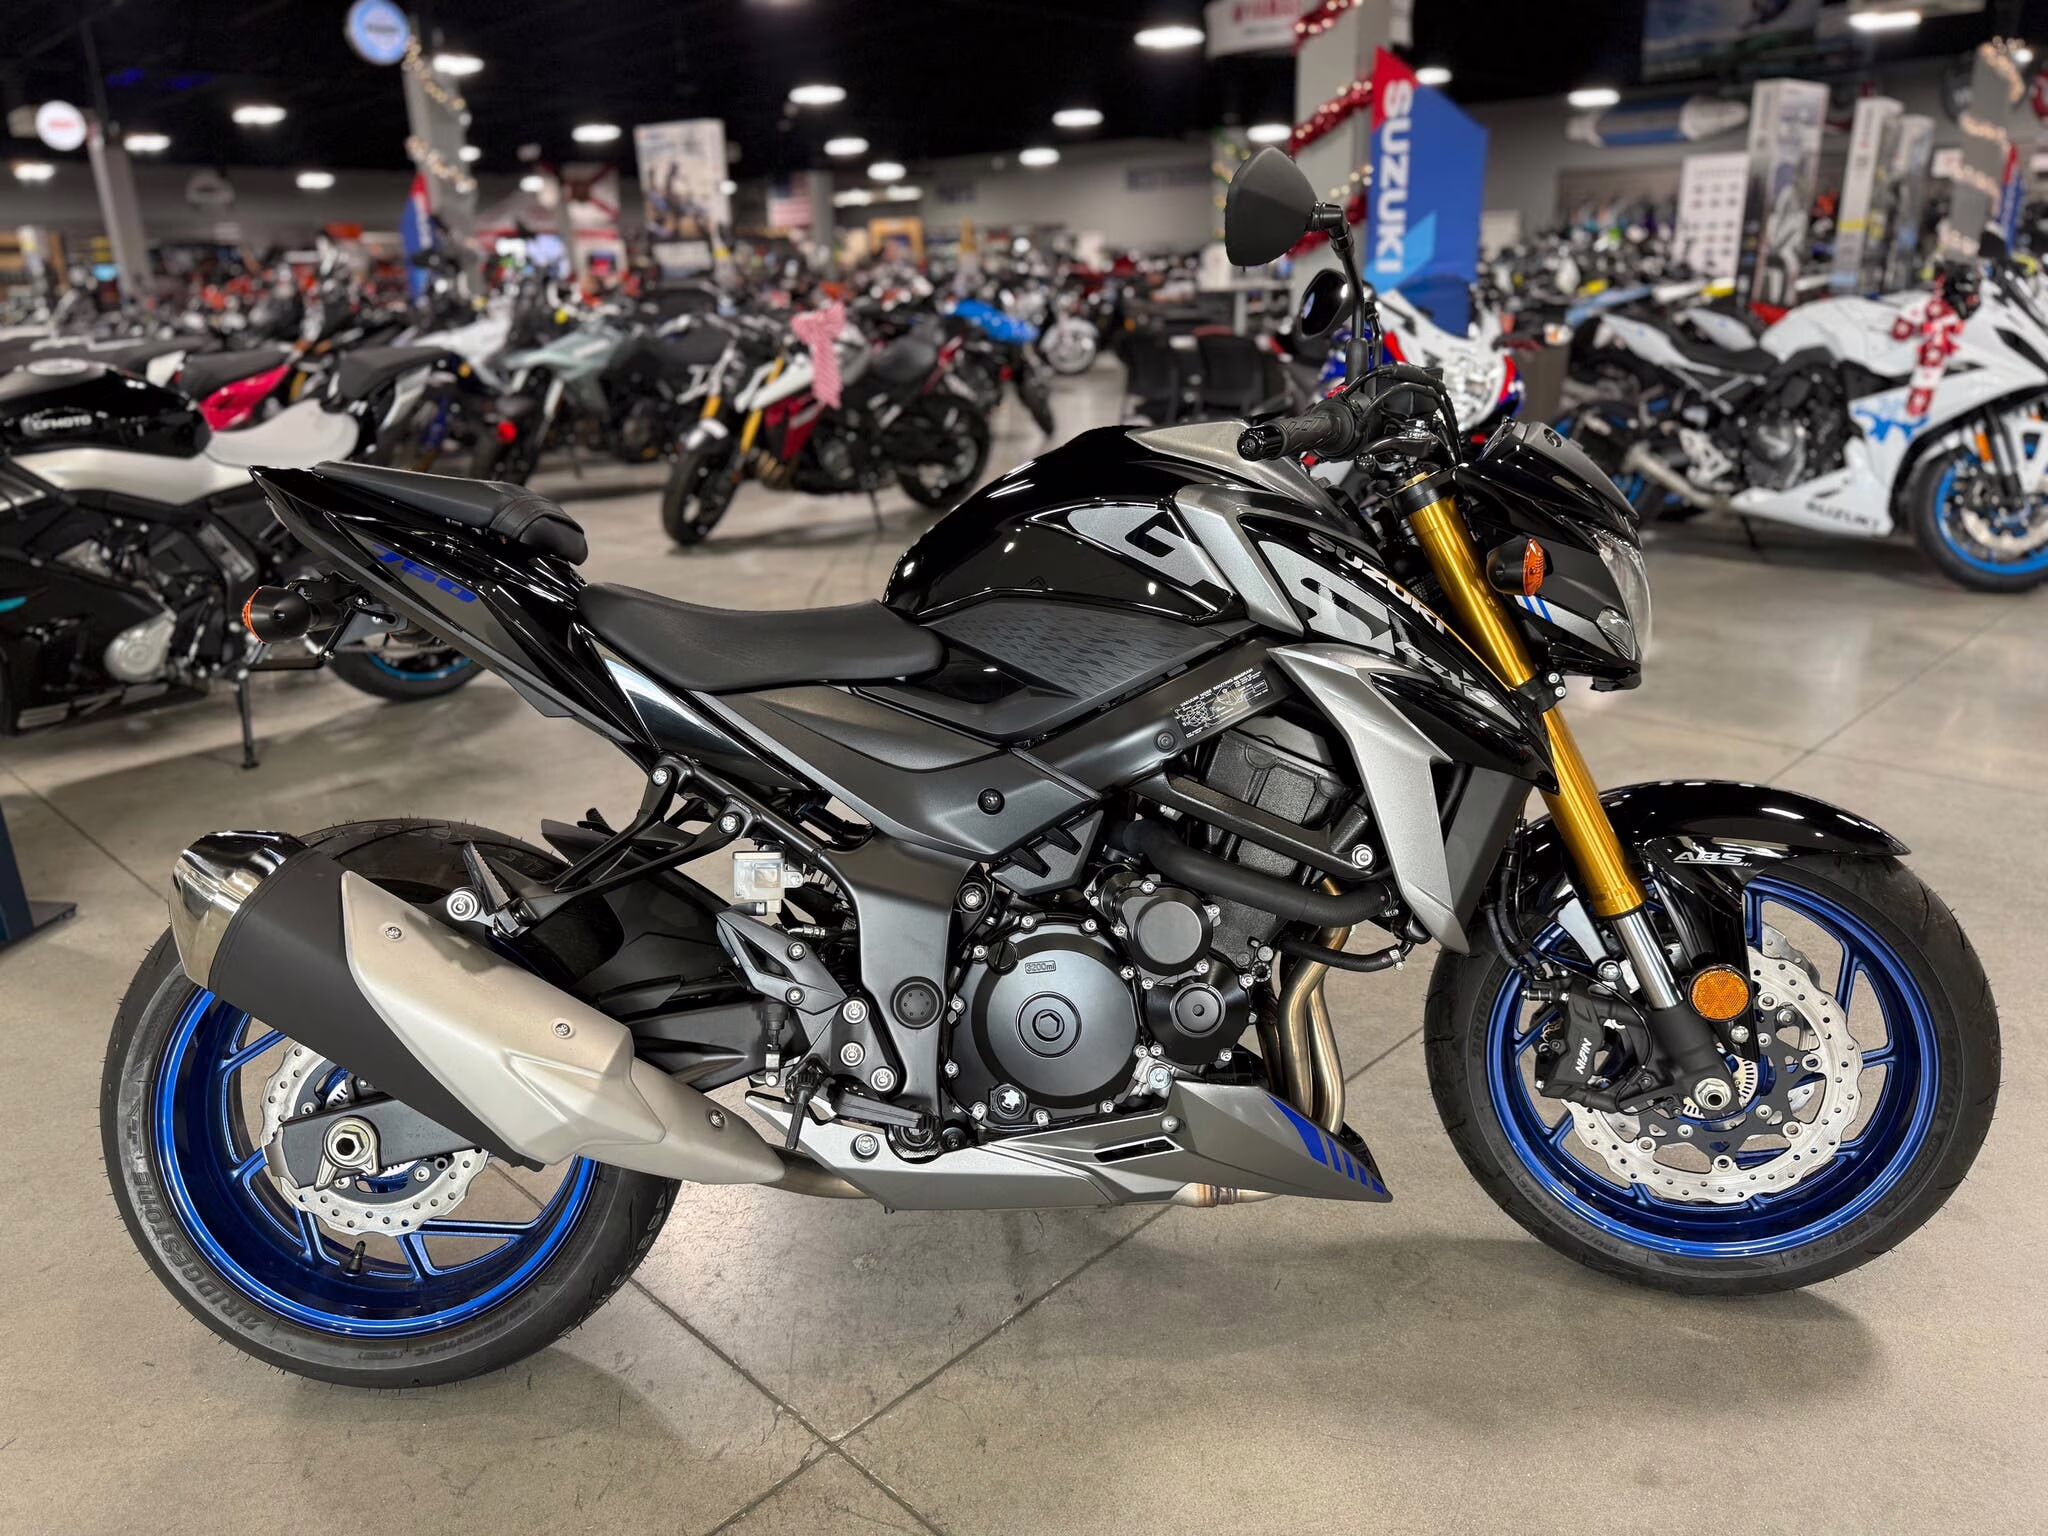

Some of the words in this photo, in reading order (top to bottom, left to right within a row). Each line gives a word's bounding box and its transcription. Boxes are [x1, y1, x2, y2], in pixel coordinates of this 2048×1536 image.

[1376, 79, 1414, 273] SUZUKI
[1805, 500, 1881, 530] SUZUKI
[372, 543, 479, 604] 750
[1307, 531, 1445, 635] SUZUKI
[1394, 640, 1500, 708] GSX-S
[1673, 851, 1746, 864] ABS
[1026, 962, 1055, 972] 3200ml
[132, 1171, 266, 1332] BRIDGESTONE
